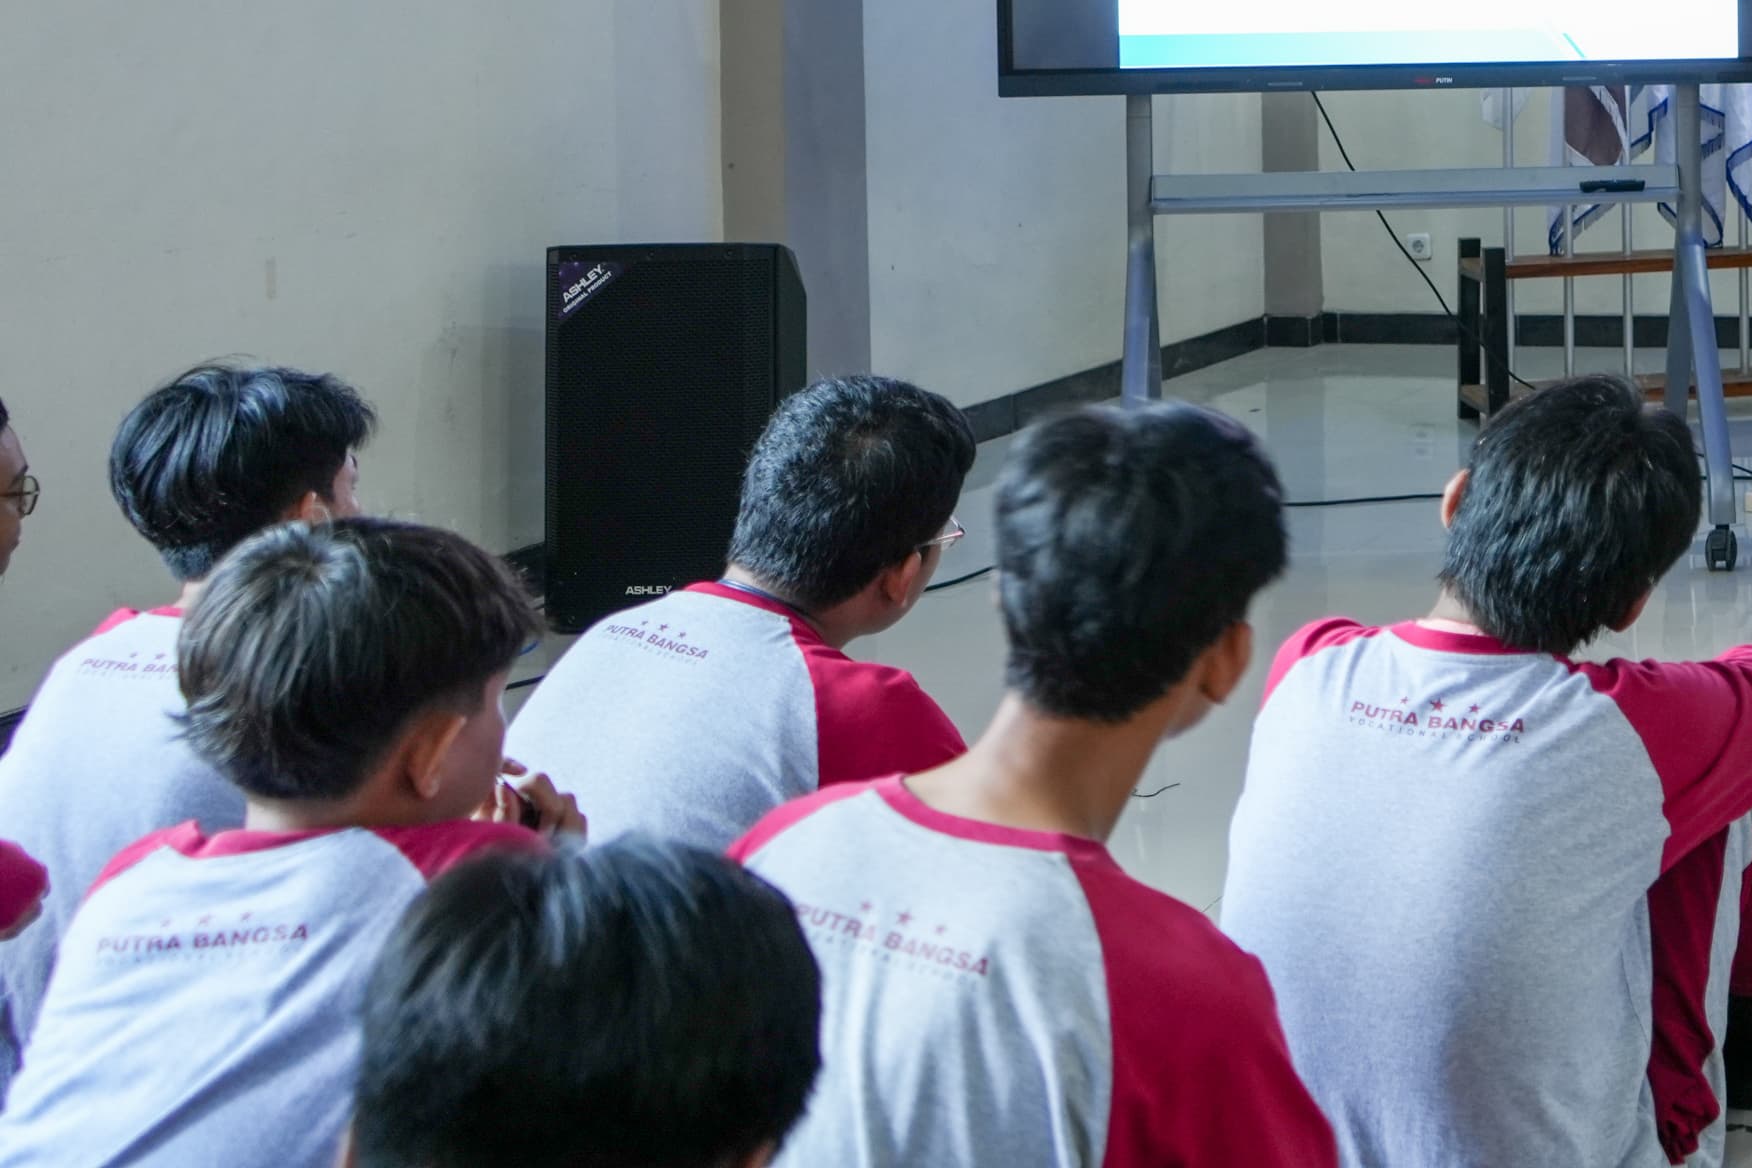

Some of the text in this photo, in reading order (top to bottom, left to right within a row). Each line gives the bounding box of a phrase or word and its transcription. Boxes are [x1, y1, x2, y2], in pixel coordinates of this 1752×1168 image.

[563, 264, 603, 303] ASHLEY
[587, 270, 612, 293] PRODUCT
[625, 585, 672, 595] ASHLEY
[605, 624, 646, 640] PUTRA
[647, 633, 709, 659] BANGSA
[81, 658, 138, 671] PUTRA
[1351, 700, 1525, 734] PUTRA BANGSA
[97, 922, 309, 953] PUTRA BANGSA
[795, 903, 877, 942] PUTRA
[883, 930, 990, 977] BANGSA
